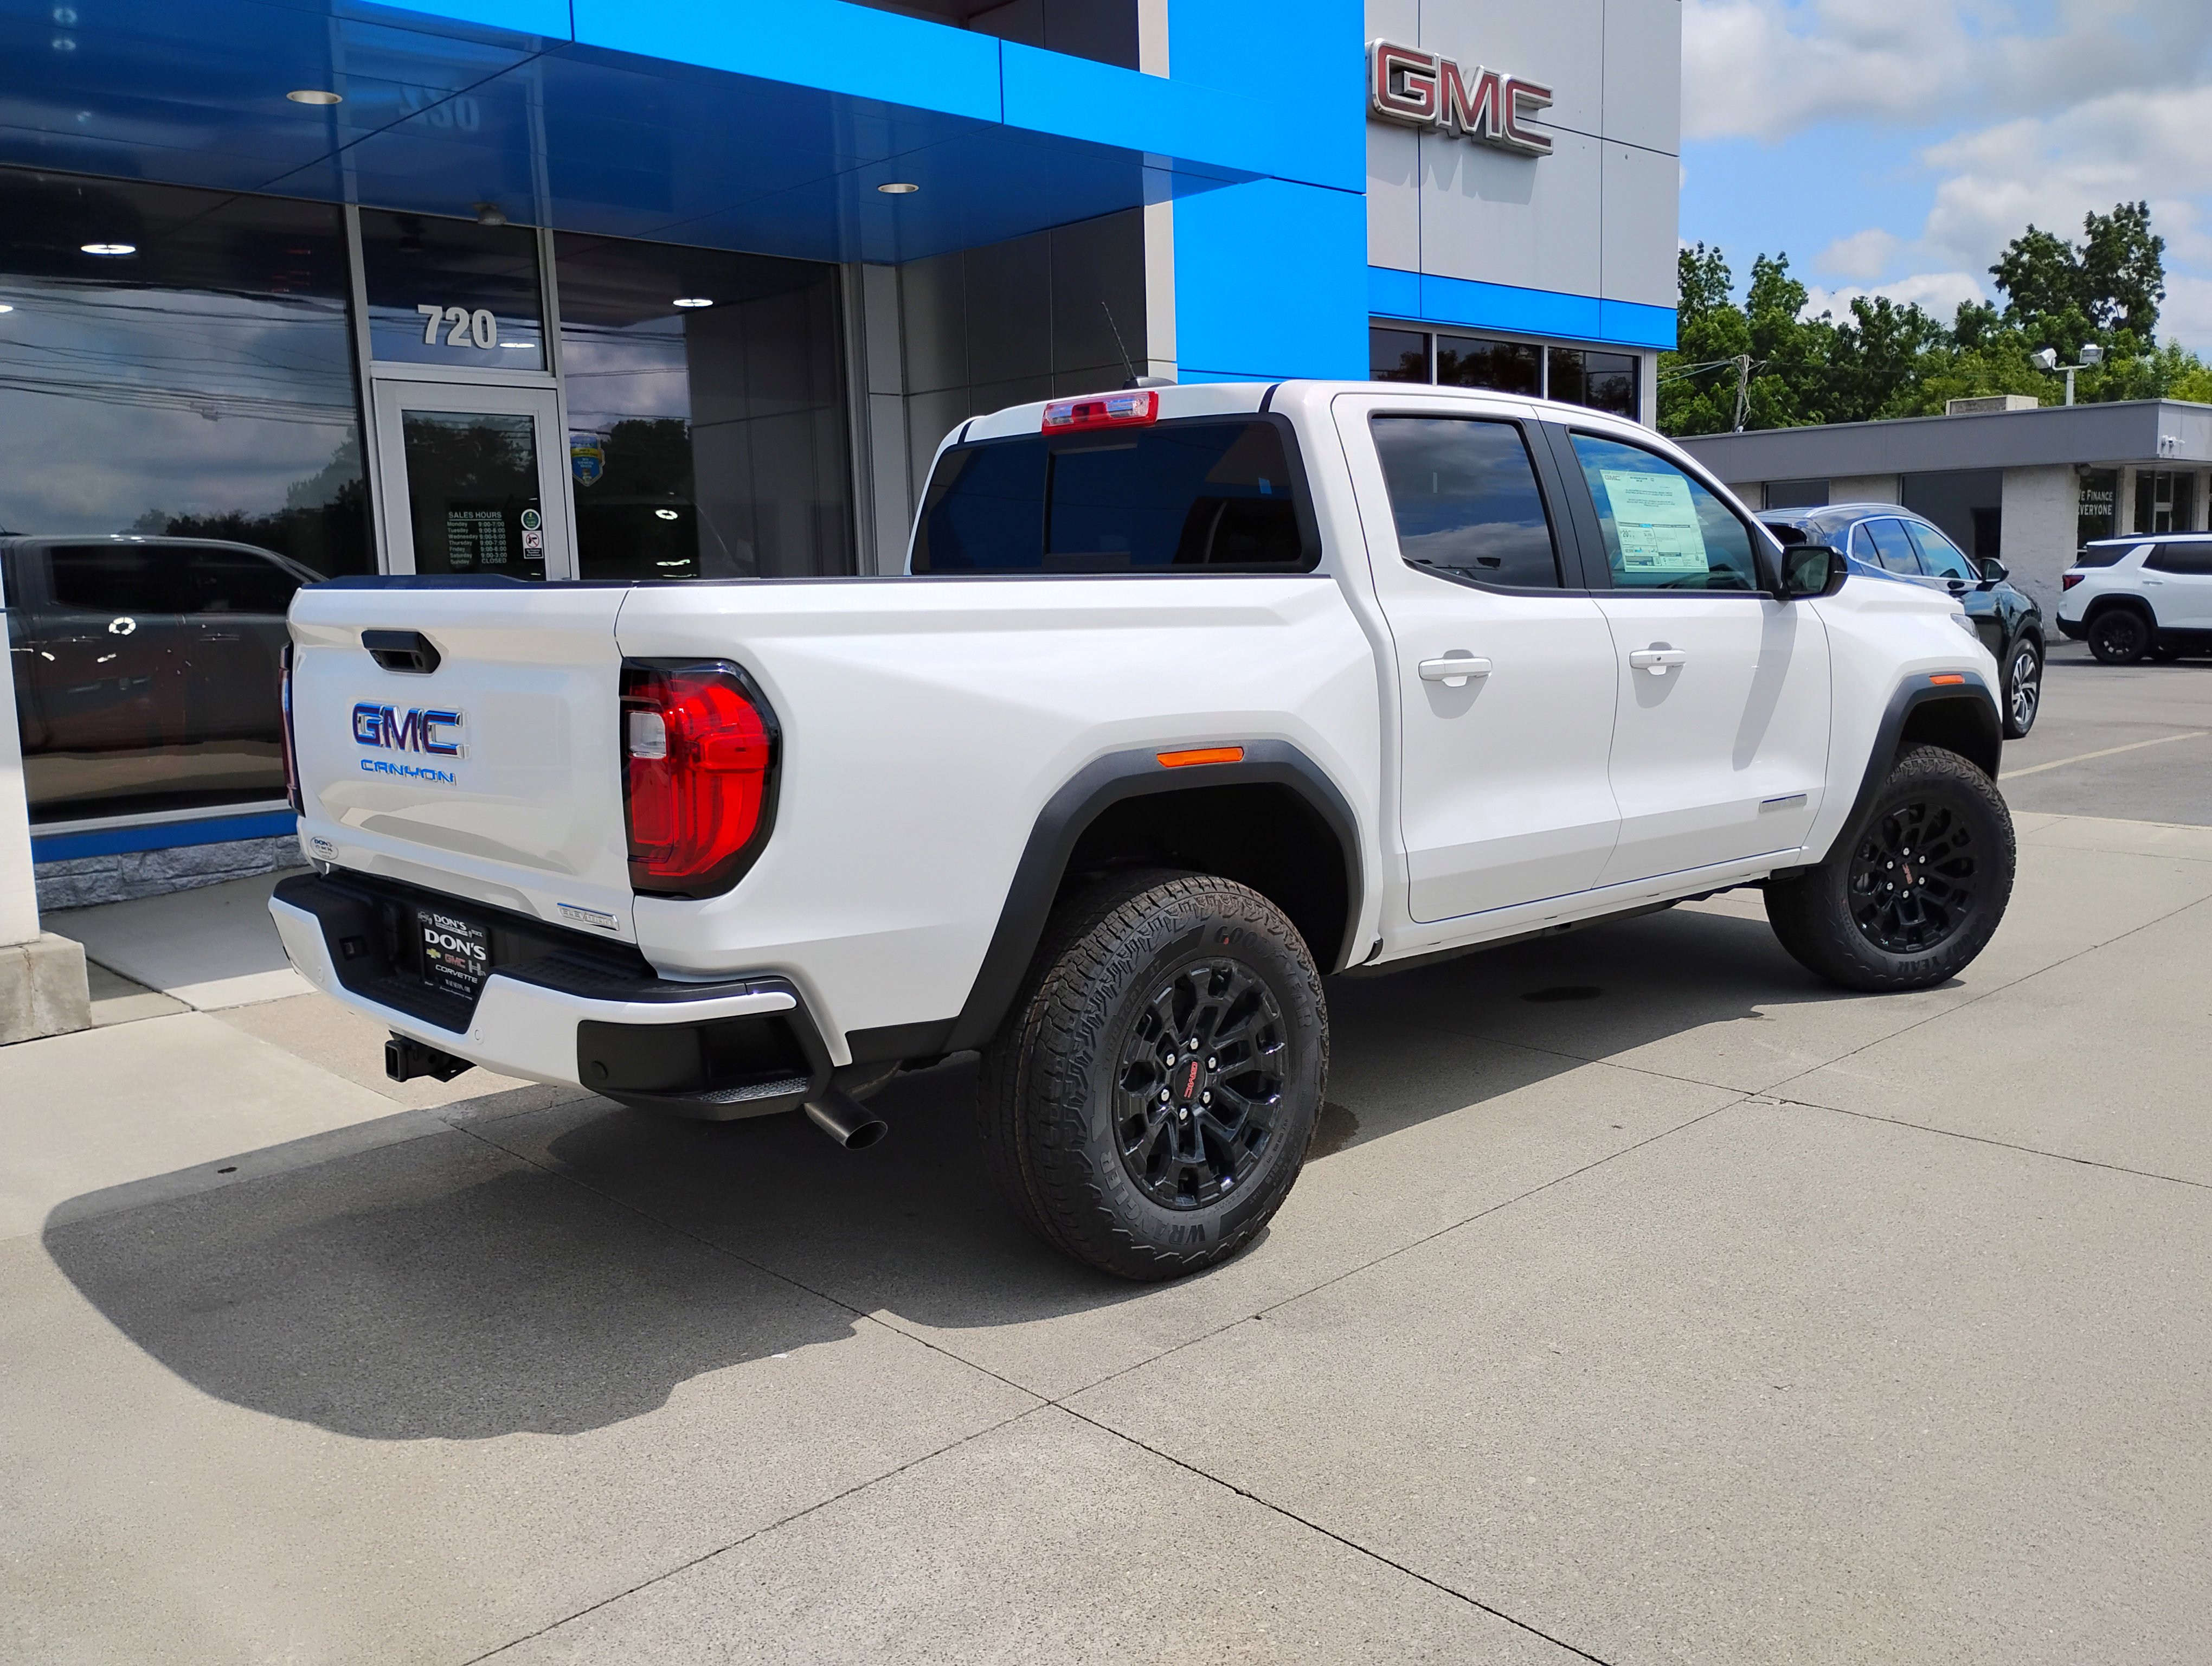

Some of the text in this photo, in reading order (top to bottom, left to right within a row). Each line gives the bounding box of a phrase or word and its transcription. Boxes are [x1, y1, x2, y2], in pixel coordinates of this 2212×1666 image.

[1366, 38, 1554, 156] GMC
[418, 304, 497, 349] 720
[2079, 489, 2113, 501] E FINANCE
[2078, 504, 2112, 515] VERYONE
[352, 702, 465, 759] GMC
[361, 759, 456, 785] CANYON
[433, 914, 467, 931] DON'S
[561, 908, 612, 926] ELEVATION
[425, 928, 486, 960] DON'S
[435, 964, 478, 983] CORVETTE
[445, 953, 465, 969] GMC
[1184, 1061, 1198, 1098] GMC
[1100, 1150, 1206, 1245] WRANGLER
